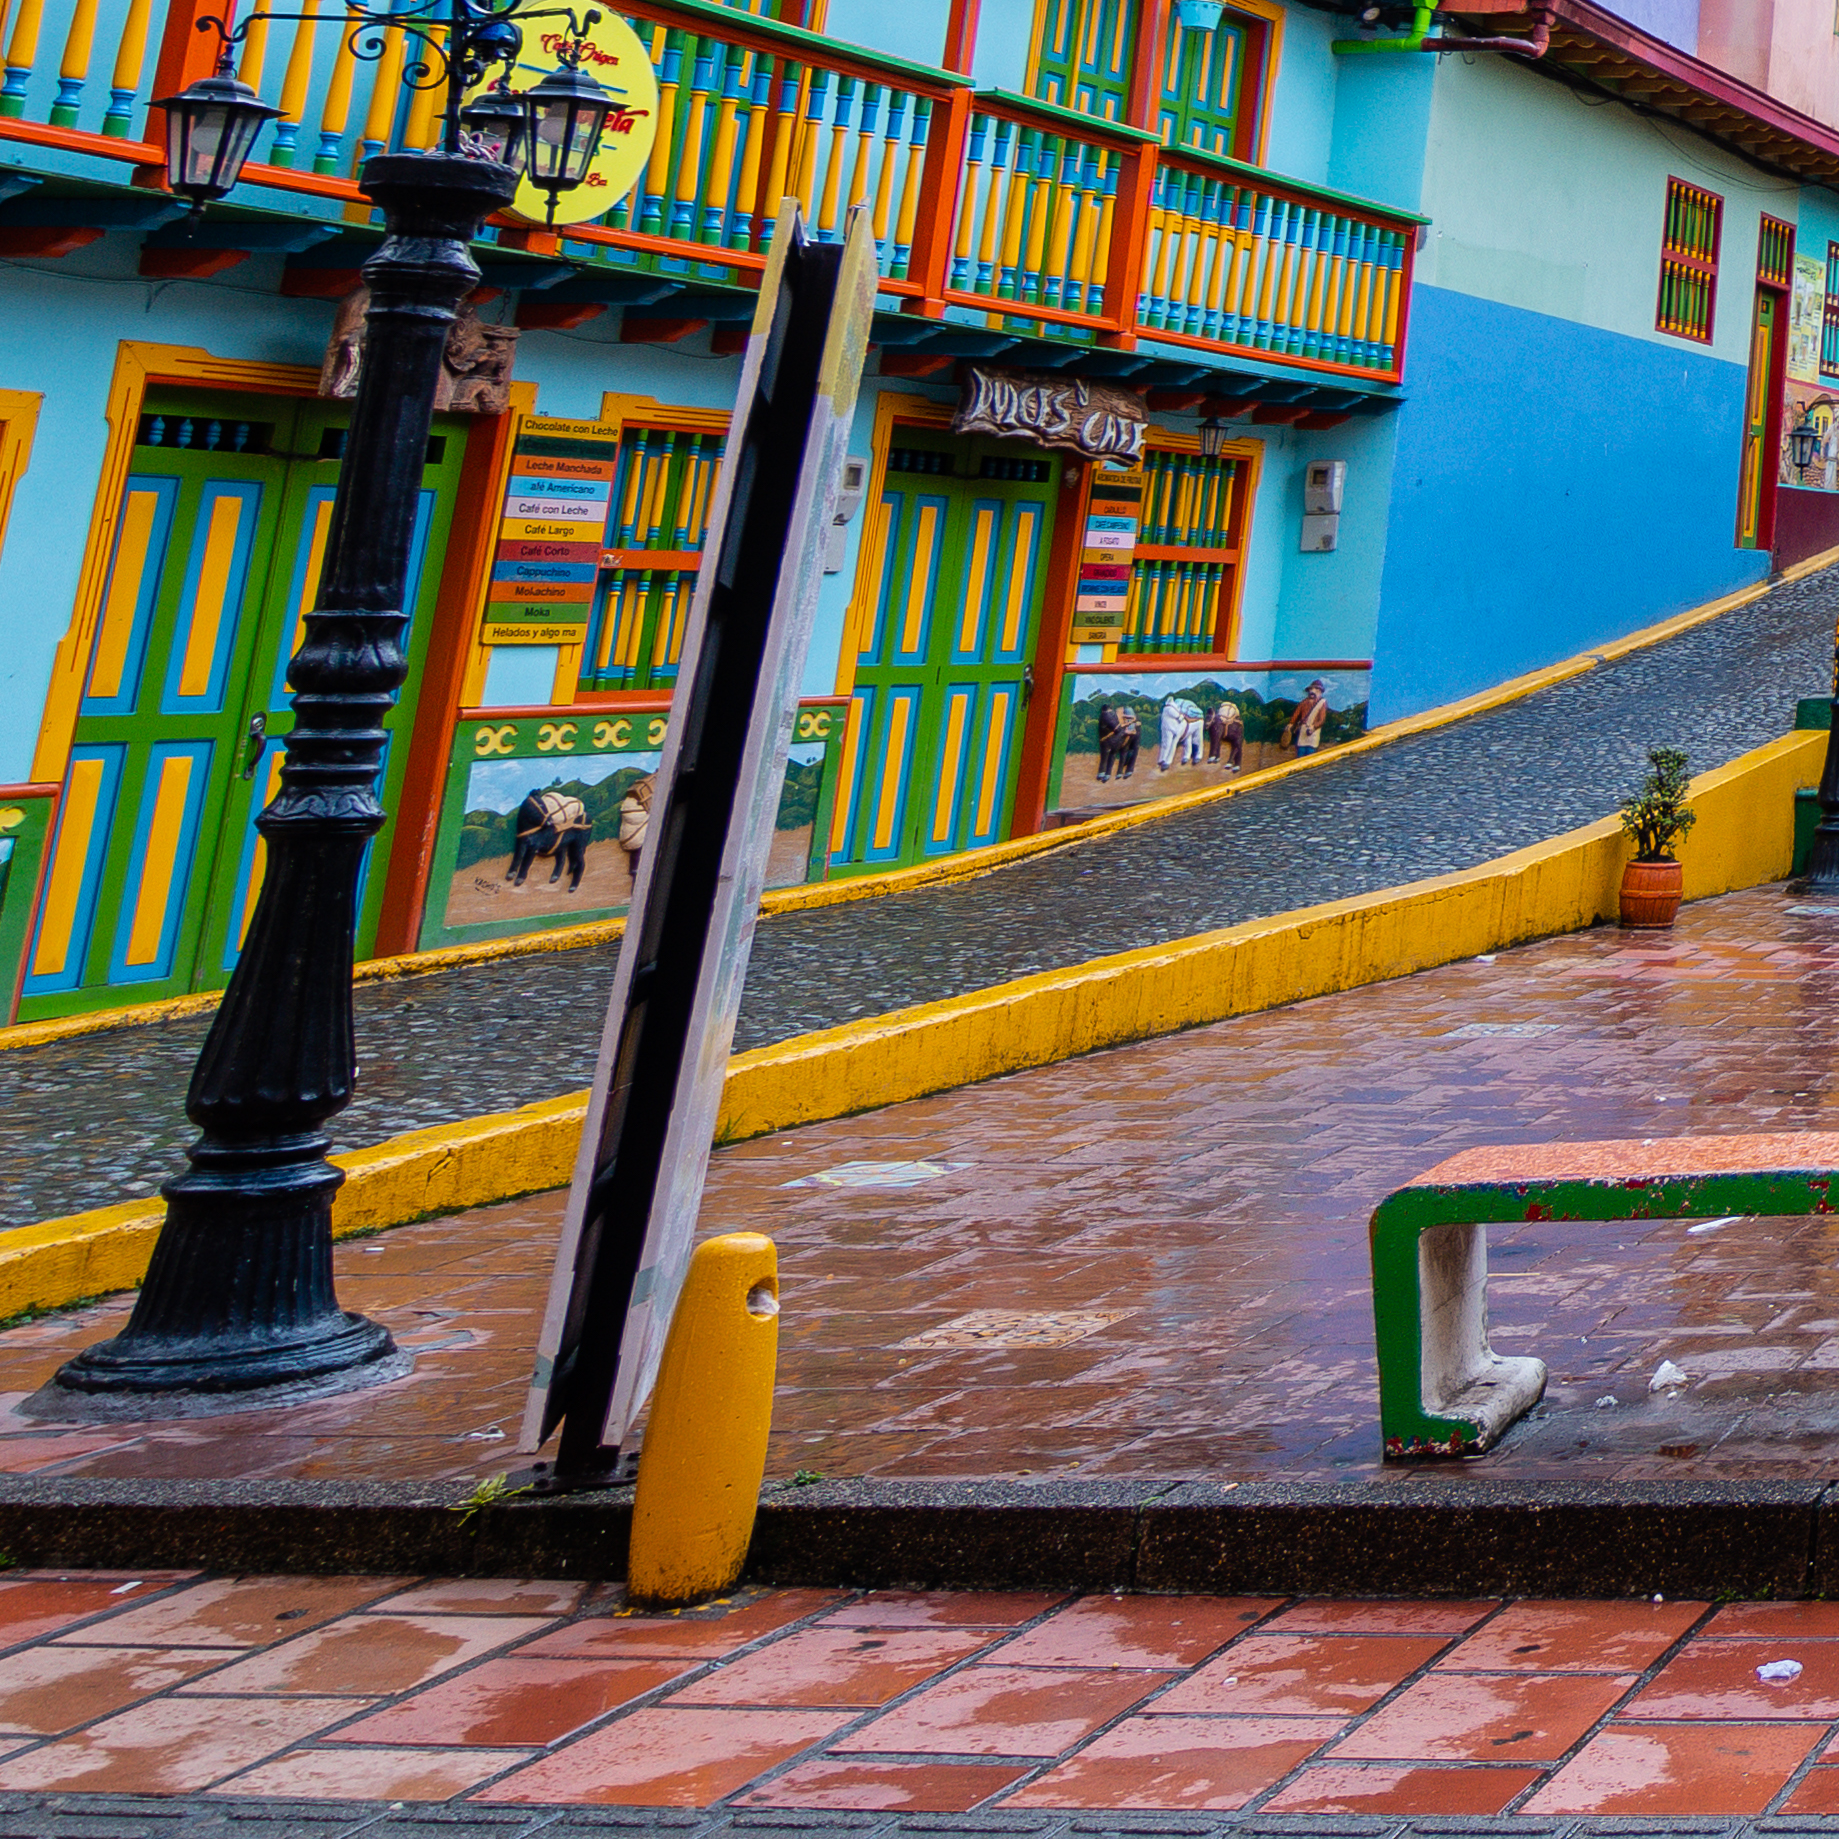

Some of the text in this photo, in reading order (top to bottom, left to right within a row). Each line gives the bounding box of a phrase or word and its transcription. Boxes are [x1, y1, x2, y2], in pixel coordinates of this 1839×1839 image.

[579, 42, 619, 66] Origen
[968, 366, 1073, 435] DULCES
[525, 420, 619, 436] Chocolate con Leche
[1079, 411, 1149, 458] CAFE
[526, 460, 602, 475] Leche Manchada
[547, 483, 595, 494] Americano
[519, 503, 589, 515] Café con Leche
[525, 524, 575, 537] Café Largo
[521, 545, 570, 556] Café Corto
[517, 566, 571, 578] Cappuchino
[524, 607, 550, 617] Moka
[492, 627, 530, 637] Helados
[532, 630, 539, 639] y
[540, 628, 560, 639] algo
